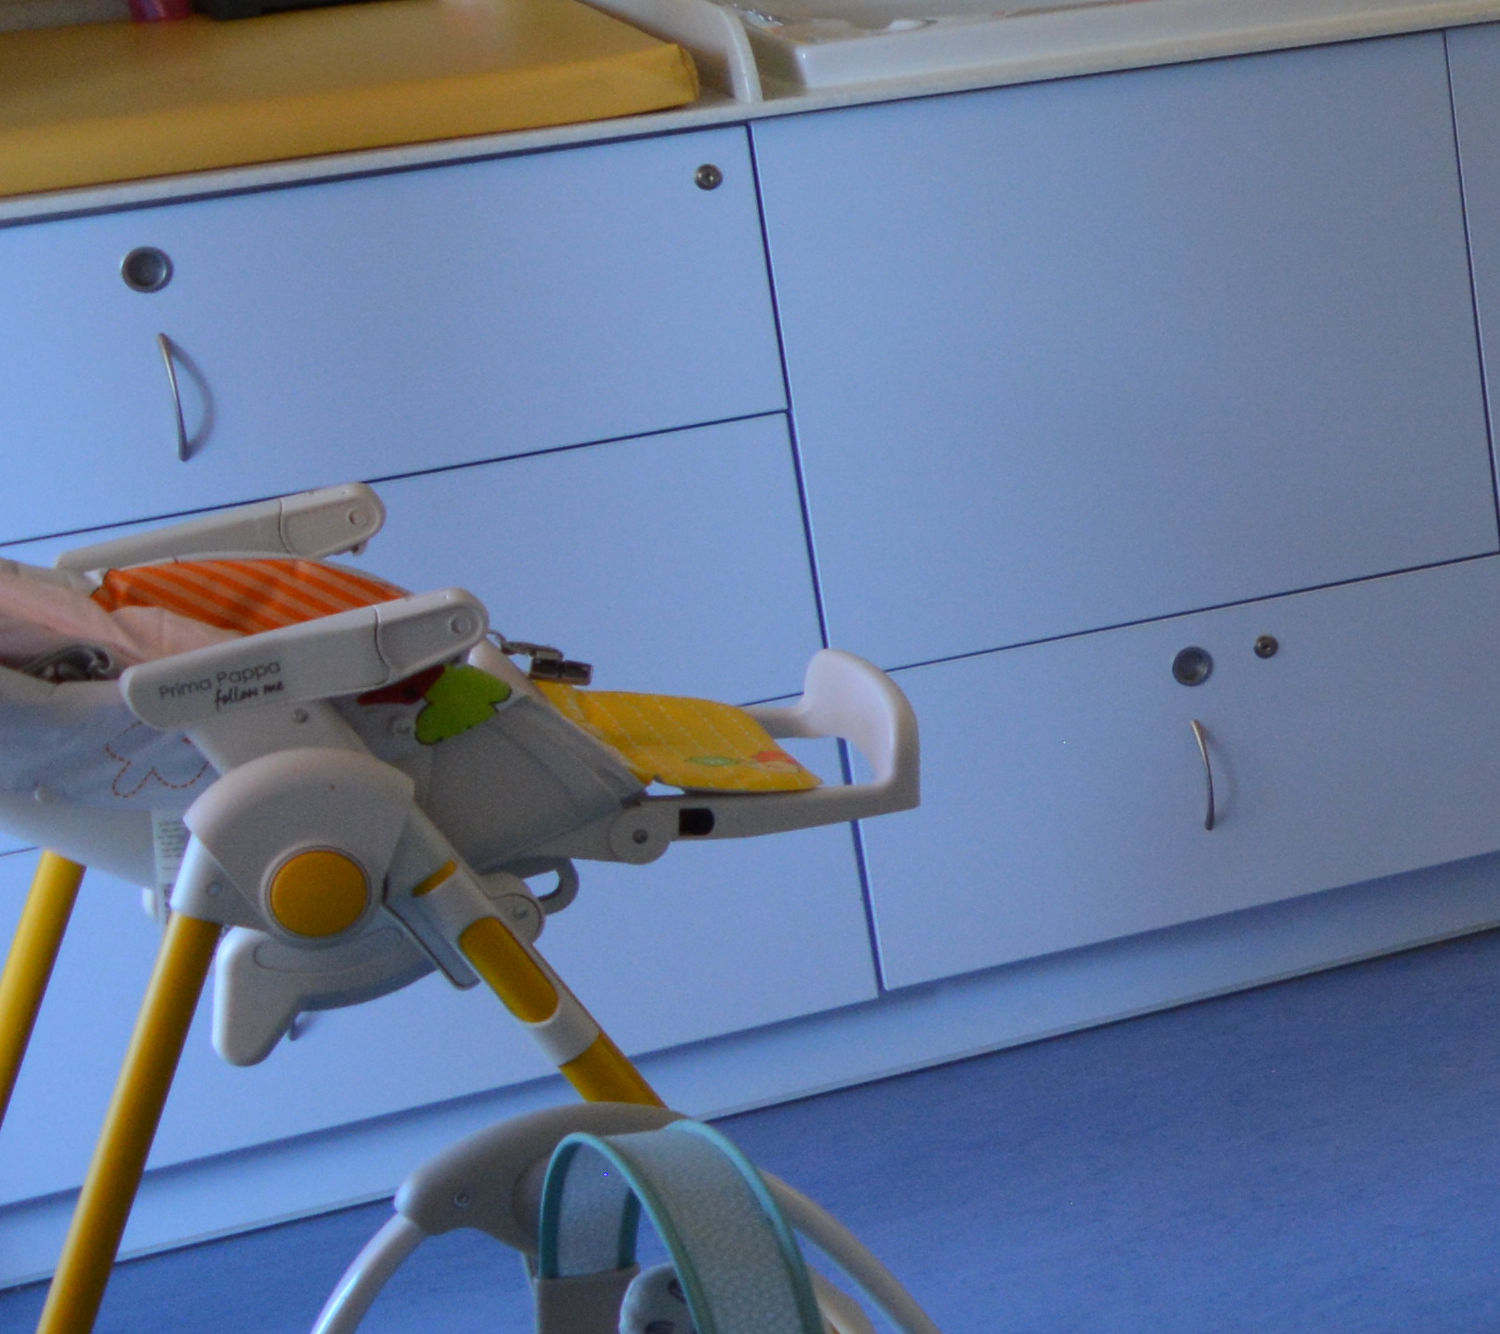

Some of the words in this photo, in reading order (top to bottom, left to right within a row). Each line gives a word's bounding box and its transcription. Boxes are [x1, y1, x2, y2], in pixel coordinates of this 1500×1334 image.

[158, 678, 212, 700] Prima
[216, 661, 281, 686] Pappa
[215, 687, 260, 711] follow
[263, 681, 285, 694] me
